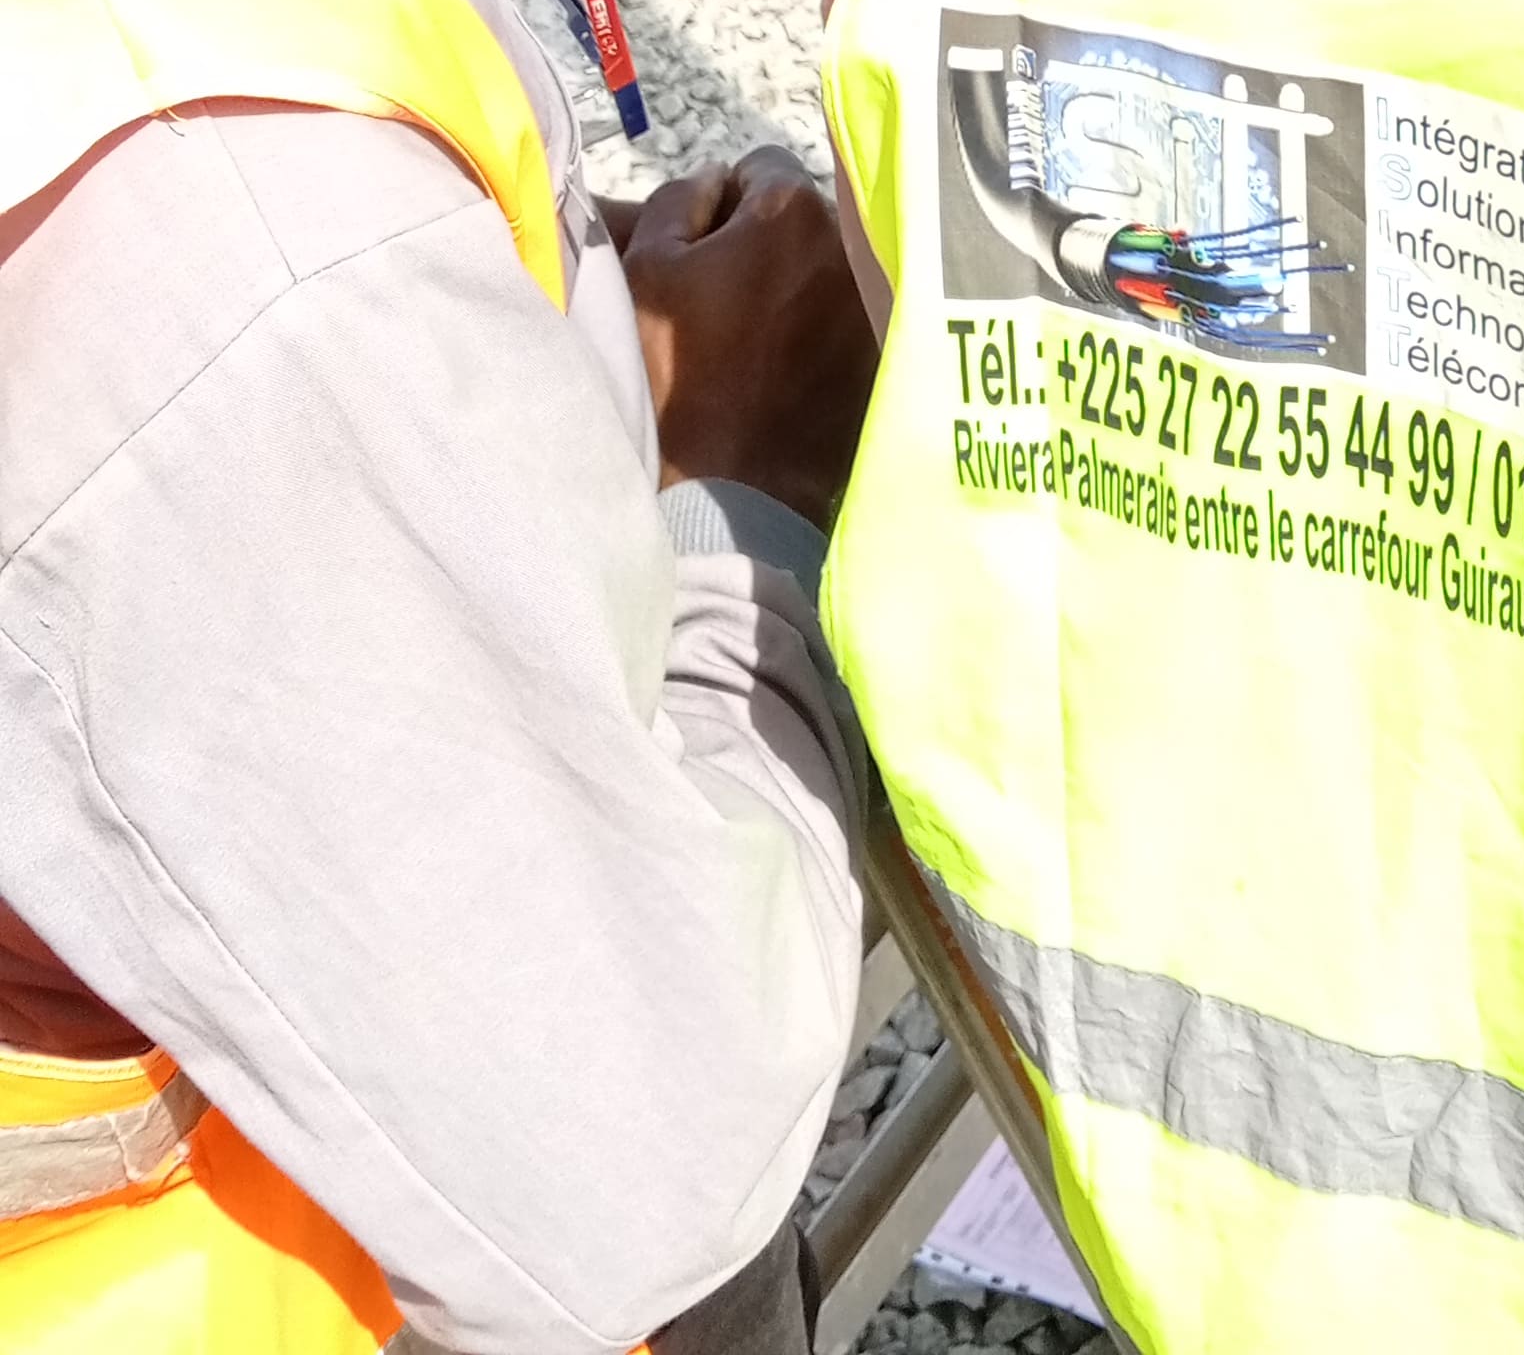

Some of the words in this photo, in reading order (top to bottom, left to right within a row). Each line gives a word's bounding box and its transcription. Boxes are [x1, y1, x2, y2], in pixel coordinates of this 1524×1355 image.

[954, 419, 1057, 493] Riviera
[1060, 428, 1178, 544] Palmeraie
[1185, 484, 1259, 559] entre
[1268, 489, 1294, 563] le
[1304, 508, 1433, 601] carrefour
[1057, 331, 1147, 438] +225
[1157, 354, 1198, 456] 27
[1212, 375, 1262, 471] 22
[1278, 386, 1330, 479] 55
[1345, 394, 1394, 495] 44
[1408, 409, 1455, 515] 99
[1466, 429, 1482, 526] /
